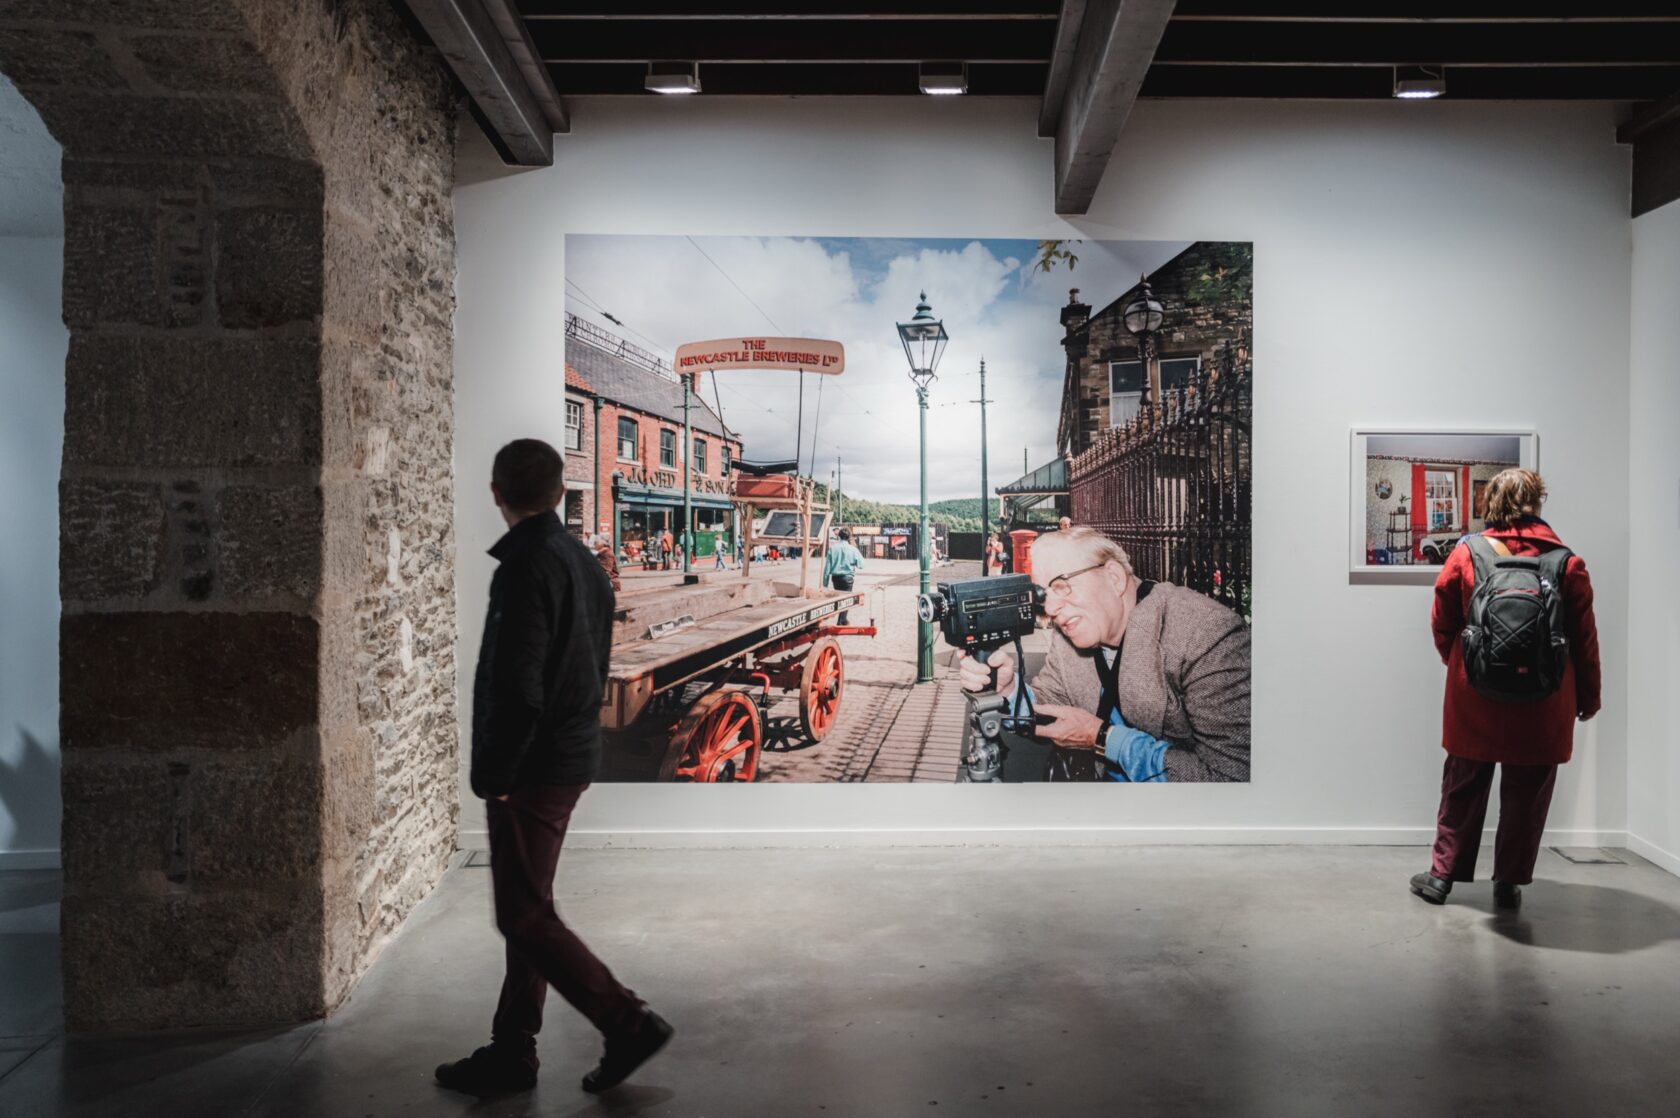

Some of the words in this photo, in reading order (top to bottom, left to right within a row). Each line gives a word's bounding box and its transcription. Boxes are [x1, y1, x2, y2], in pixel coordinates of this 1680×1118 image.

[742, 340, 766, 350] THE
[680, 350, 750, 367] NEWCASTLE
[753, 350, 820, 365] BREWERIES
[768, 613, 807, 638] NEWCASTLE
